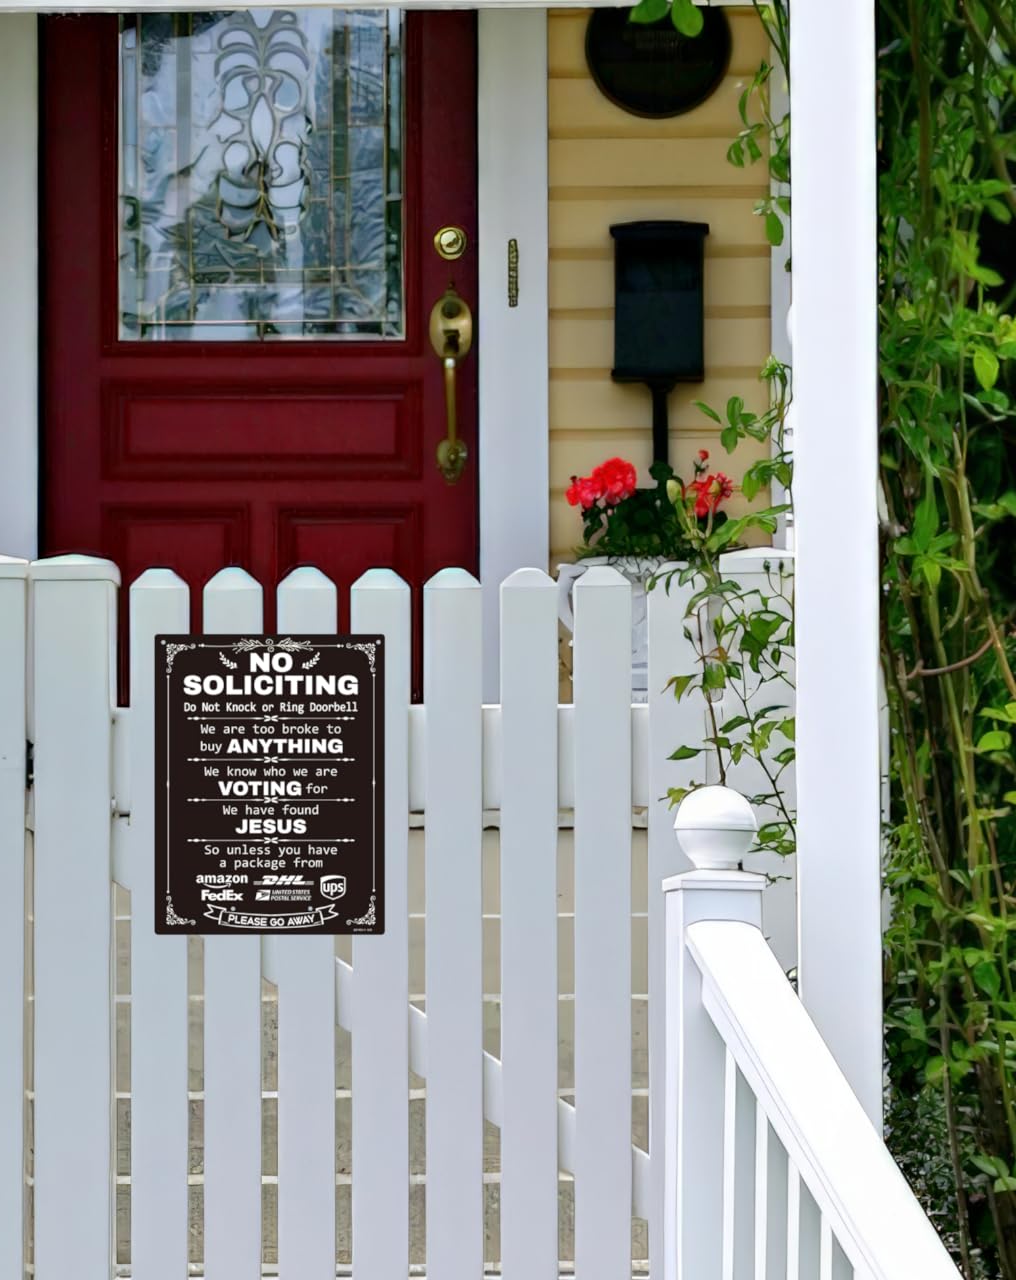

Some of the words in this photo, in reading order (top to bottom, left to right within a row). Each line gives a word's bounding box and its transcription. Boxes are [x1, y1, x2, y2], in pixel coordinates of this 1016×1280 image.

[250, 653, 293, 672] NO
[183, 675, 359, 695] SOLICITING
[184, 703, 196, 712] Do
[202, 703, 220, 712] Not
[226, 702, 256, 712] Knock
[262, 704, 274, 712] or
[280, 702, 304, 714] Ring
[310, 702, 358, 712] Doorbell
[200, 725, 215, 734] We
[223, 726, 245, 734] are
[253, 725, 274, 734] too
[282, 725, 319, 734] broke
[327, 725, 341, 734] to
[200, 741, 222, 754] buy
[227, 739, 343, 753] ANYTHING
[204, 767, 219, 776] We
[227, 766, 256, 776] know
[264, 766, 286, 776] who
[218, 781, 302, 796] VOTING
[306, 784, 328, 794] for
[223, 806, 238, 815] We
[245, 805, 274, 815] have
[283, 805, 319, 815] found
[236, 819, 307, 834] JESUS
[204, 846, 219, 855] So
[227, 845, 270, 855] unless
[278, 847, 300, 857] you
[308, 845, 338, 855] have
[234, 858, 286, 870] package
[294, 858, 323, 867] from
[196, 875, 248, 884] amazon
[262, 875, 305, 885] DHL
[201, 890, 243, 901] FedEx
[323, 883, 343, 896] ups
[228, 915, 267, 926] PLEASE
[270, 918, 284, 927] GO
[287, 915, 315, 926] AWAY
